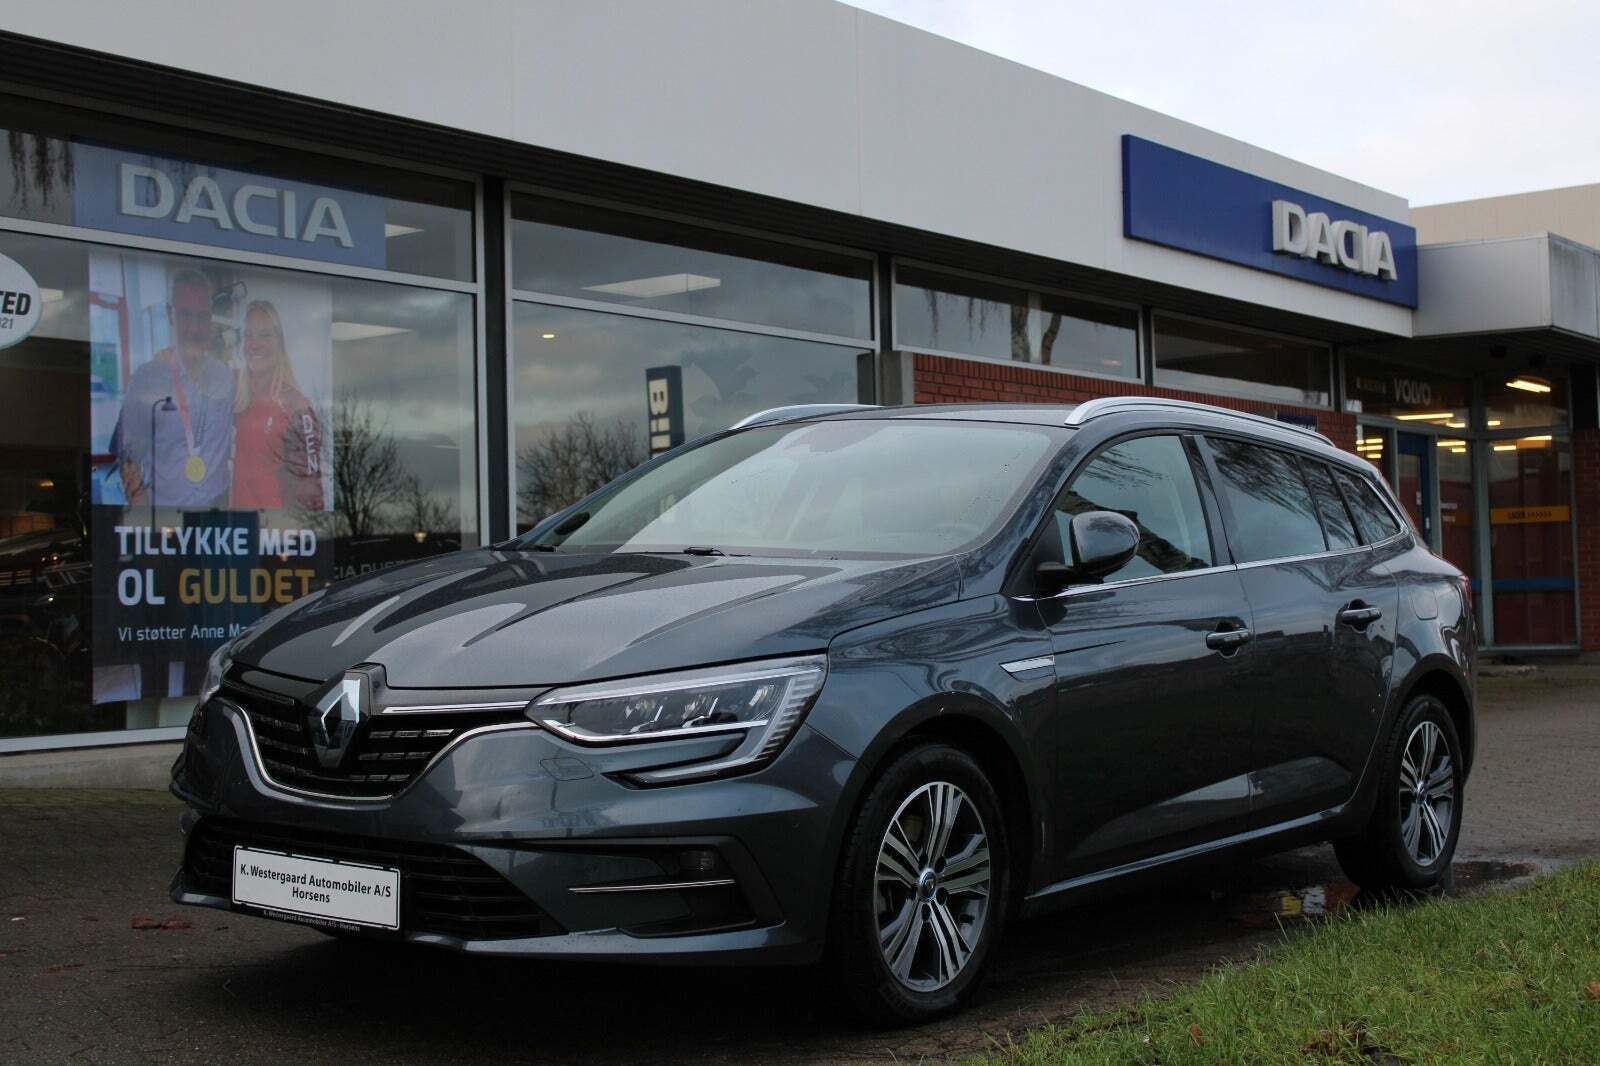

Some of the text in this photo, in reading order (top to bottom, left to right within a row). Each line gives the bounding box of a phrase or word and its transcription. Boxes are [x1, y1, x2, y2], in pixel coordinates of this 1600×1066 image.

[119, 162, 355, 248] DACIA
[1272, 199, 1398, 280] DACIA
[0, 290, 32, 316] ED
[1393, 378, 1431, 406] VOLVO
[114, 526, 317, 557] TILLYKKE MED
[118, 568, 316, 606] OL GULDET
[118, 627, 133, 642] Vi
[137, 626, 187, 641] støtter
[191, 624, 225, 640] Anne
[240, 863, 391, 898] K. Westergaard Automobiler A/S
[292, 886, 331, 904] Horsens
